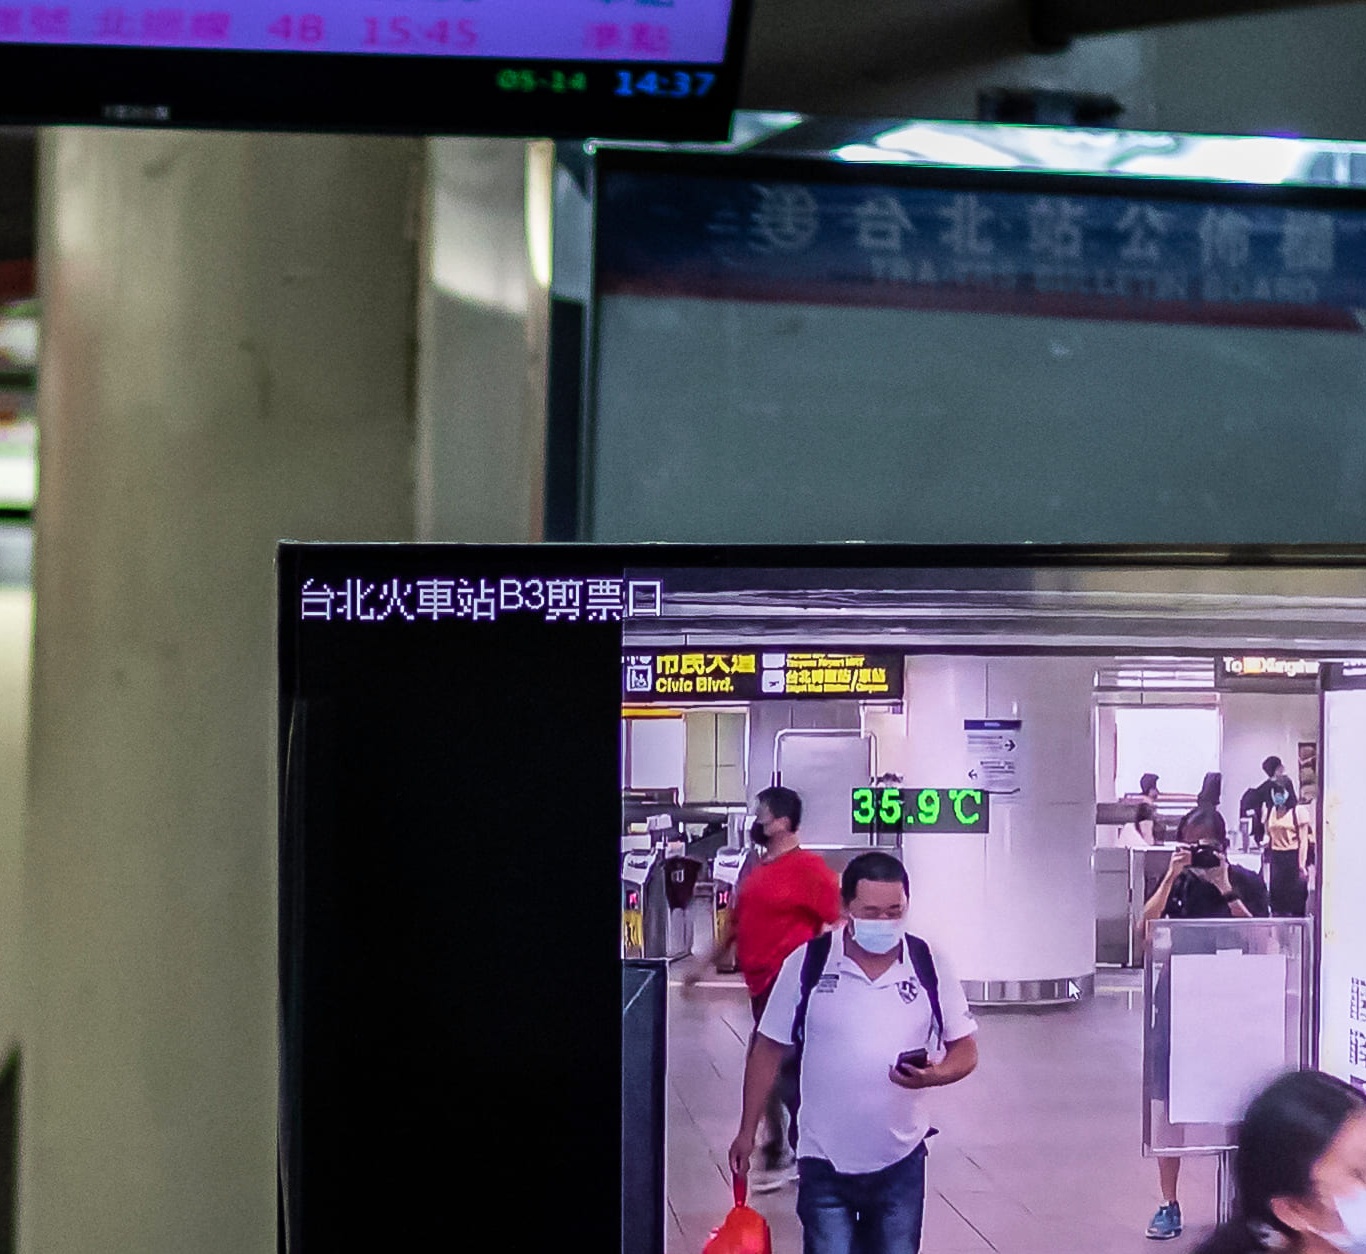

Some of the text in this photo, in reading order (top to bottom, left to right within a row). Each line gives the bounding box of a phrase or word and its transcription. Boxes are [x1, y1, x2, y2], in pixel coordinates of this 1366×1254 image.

[613, 70, 716, 97] 14:37
[301, 578, 662, 621] 台北火車站B3剪票口
[853, 788, 982, 825] 35.9°C
